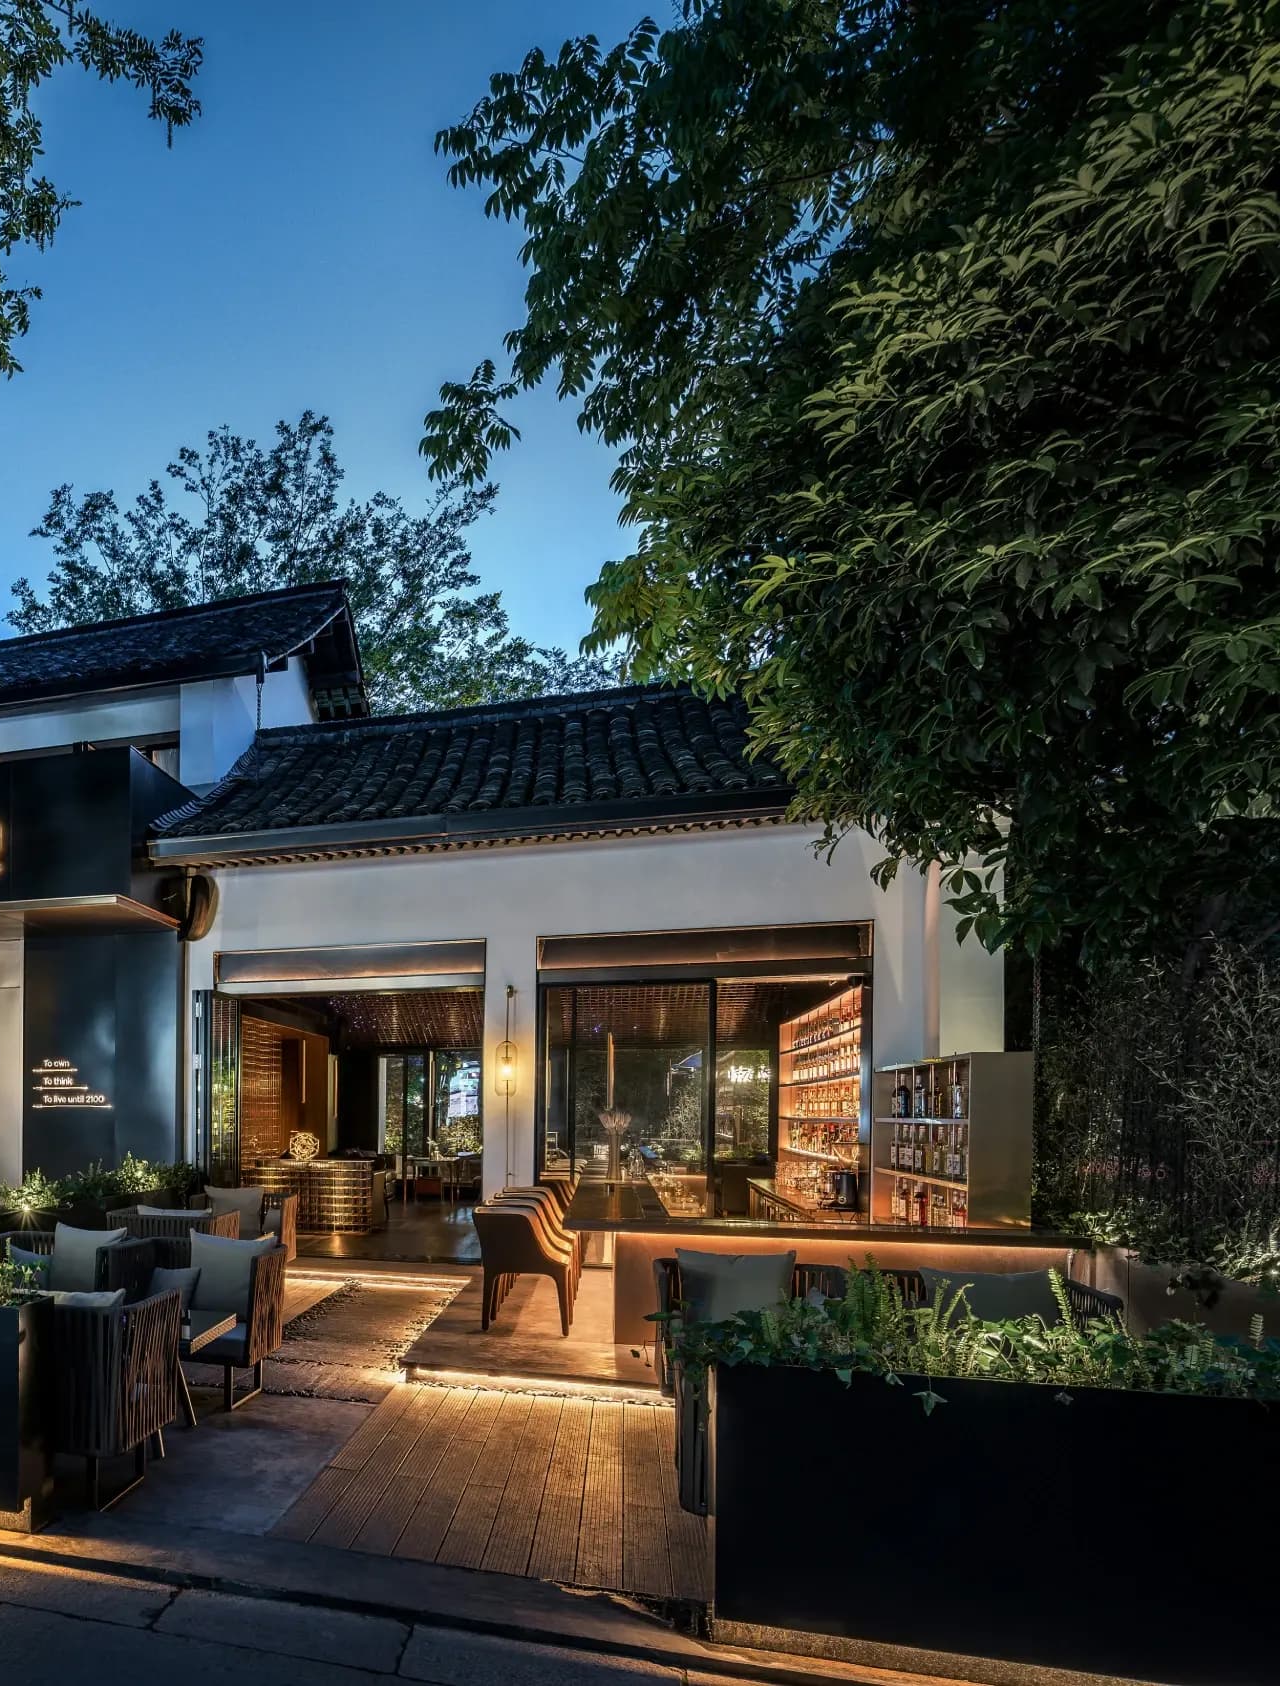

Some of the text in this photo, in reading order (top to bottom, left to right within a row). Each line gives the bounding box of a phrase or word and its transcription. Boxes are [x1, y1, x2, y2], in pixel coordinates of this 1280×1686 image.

[43, 1059, 70, 1068] To own
[43, 1077, 73, 1086] To think
[43, 1095, 105, 1104] To live until 2100
